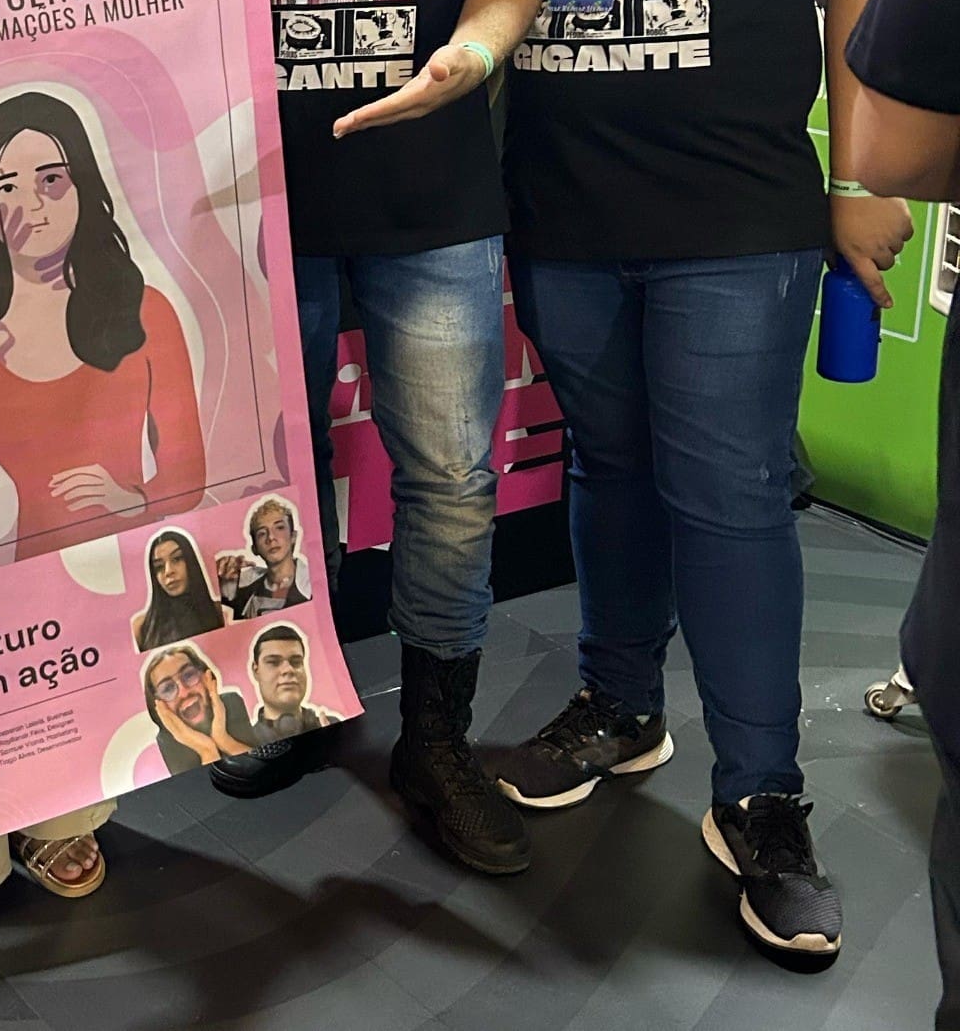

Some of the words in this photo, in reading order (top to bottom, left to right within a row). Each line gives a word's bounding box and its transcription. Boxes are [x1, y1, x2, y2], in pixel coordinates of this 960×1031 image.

[84, 4, 97, 27] A
[513, 39, 711, 73] GIGANTE
[18, 646, 100, 690] ação
